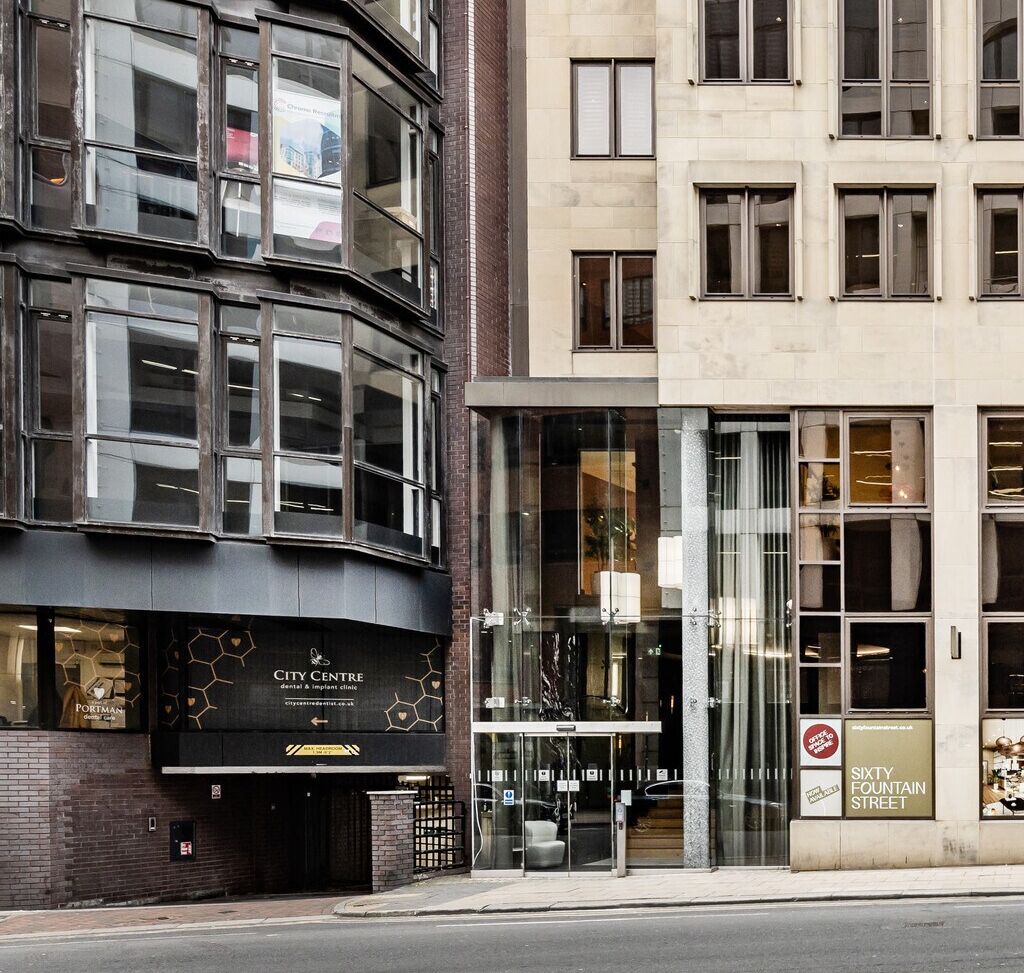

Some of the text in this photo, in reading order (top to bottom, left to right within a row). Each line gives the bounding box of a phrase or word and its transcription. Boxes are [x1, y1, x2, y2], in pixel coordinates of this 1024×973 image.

[273, 669, 364, 682] CITY CENTRE
[75, 703, 123, 714] PORTMAN
[808, 732, 834, 751] SPACE TO
[809, 729, 828, 744] OFFICE
[813, 739, 834, 754] INSPIRE
[851, 766, 894, 780] SIXTY
[806, 787, 820, 798] NOW
[810, 785, 840, 803] AVAILABLE
[851, 781, 926, 795] FOUNTAIN
[851, 796, 908, 809] STREET
